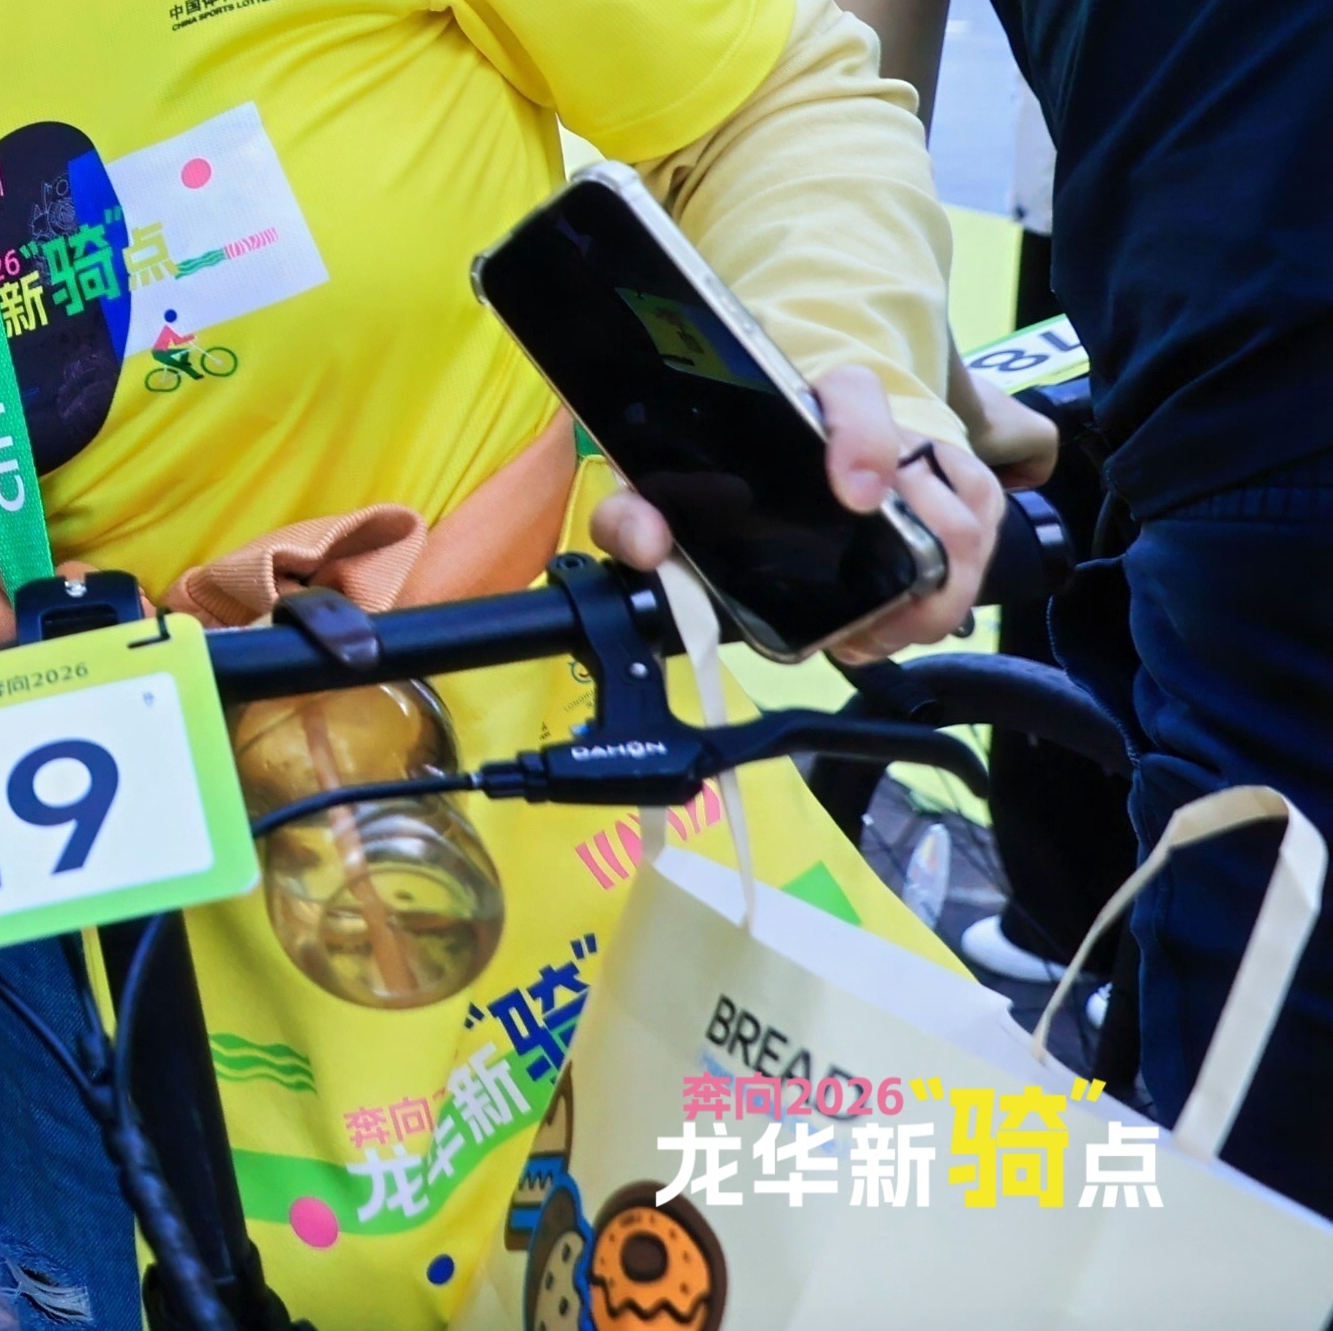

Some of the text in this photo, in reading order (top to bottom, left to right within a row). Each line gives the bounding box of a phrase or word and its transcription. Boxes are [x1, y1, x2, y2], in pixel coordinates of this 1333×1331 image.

[199, 3, 235, 21] SPORTS
[570, 741, 668, 762] DAHON
[705, 992, 868, 1122] BREAD
